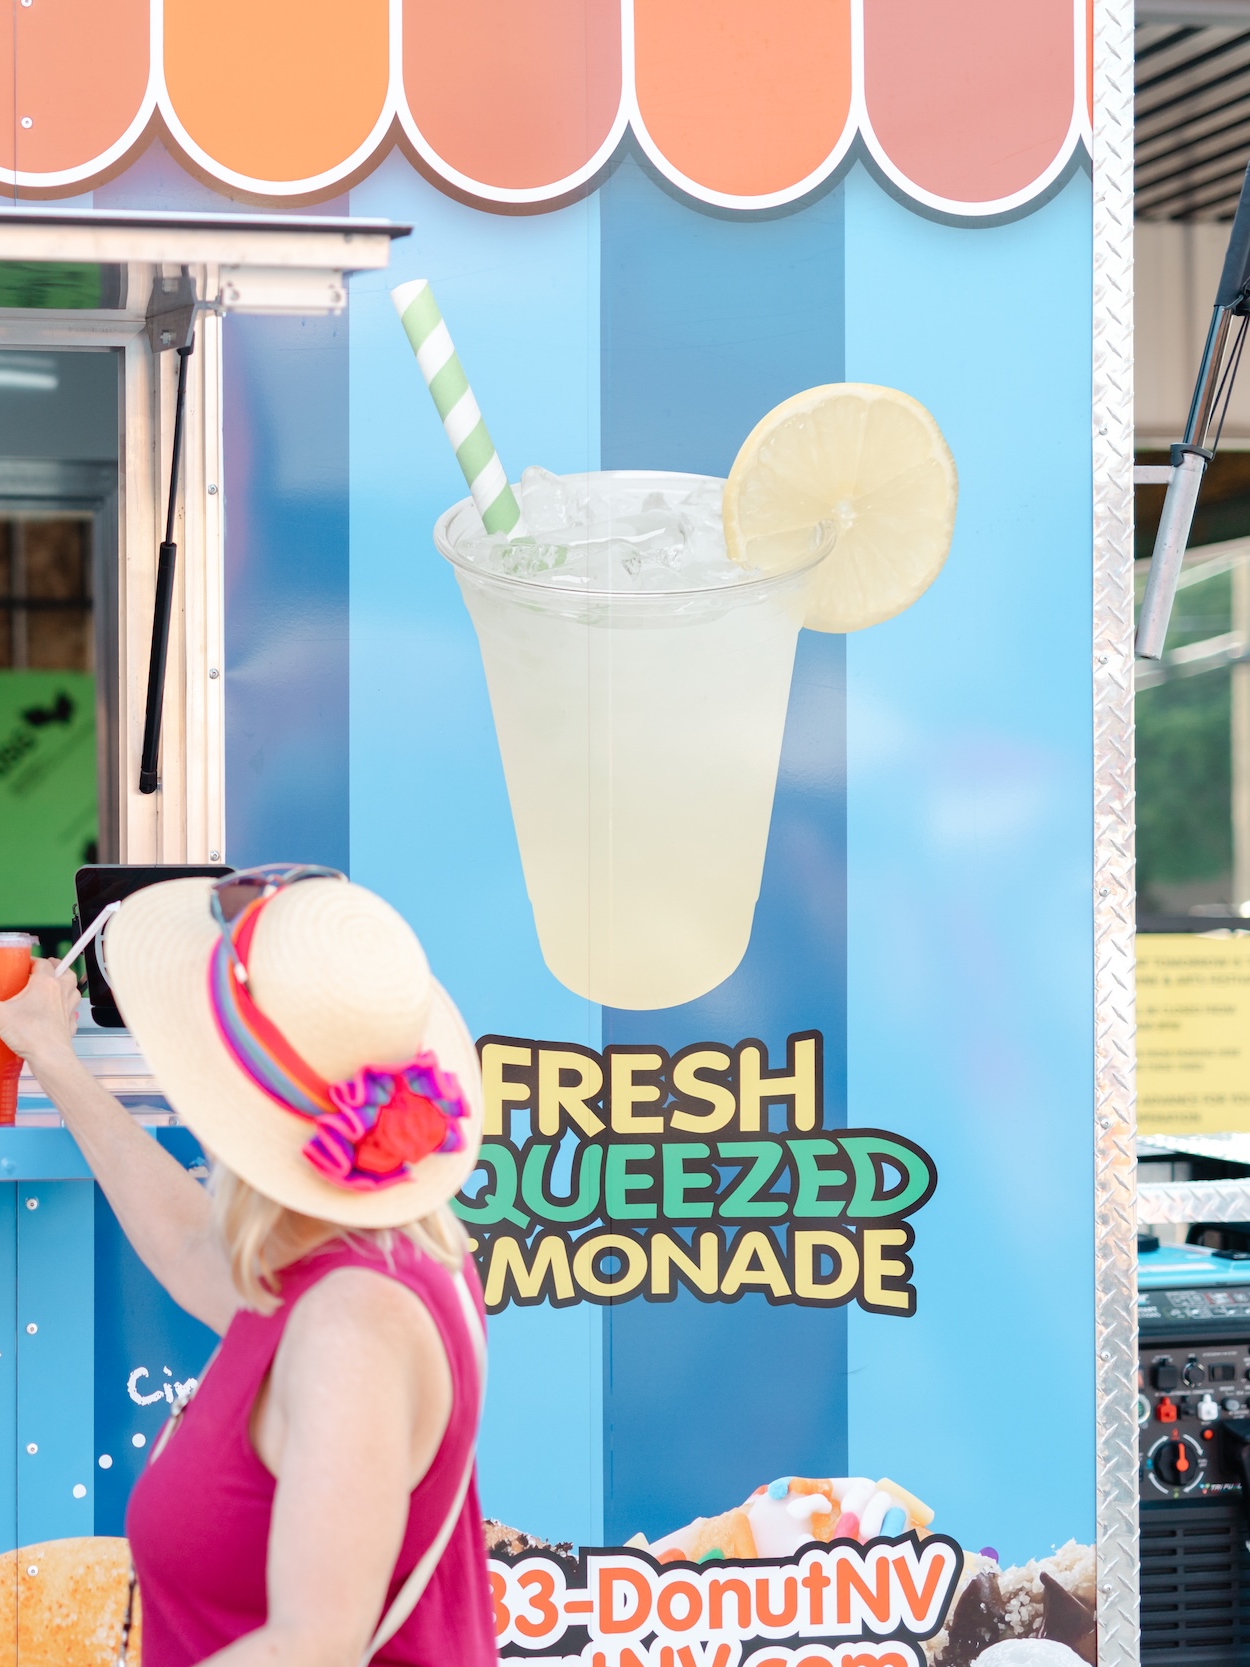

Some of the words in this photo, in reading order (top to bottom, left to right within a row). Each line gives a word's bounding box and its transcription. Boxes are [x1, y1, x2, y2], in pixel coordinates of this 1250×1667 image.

[480, 1036, 818, 1139] FRESH
[449, 1135, 931, 1230] QUEEZED
[467, 1229, 910, 1309] MONADE
